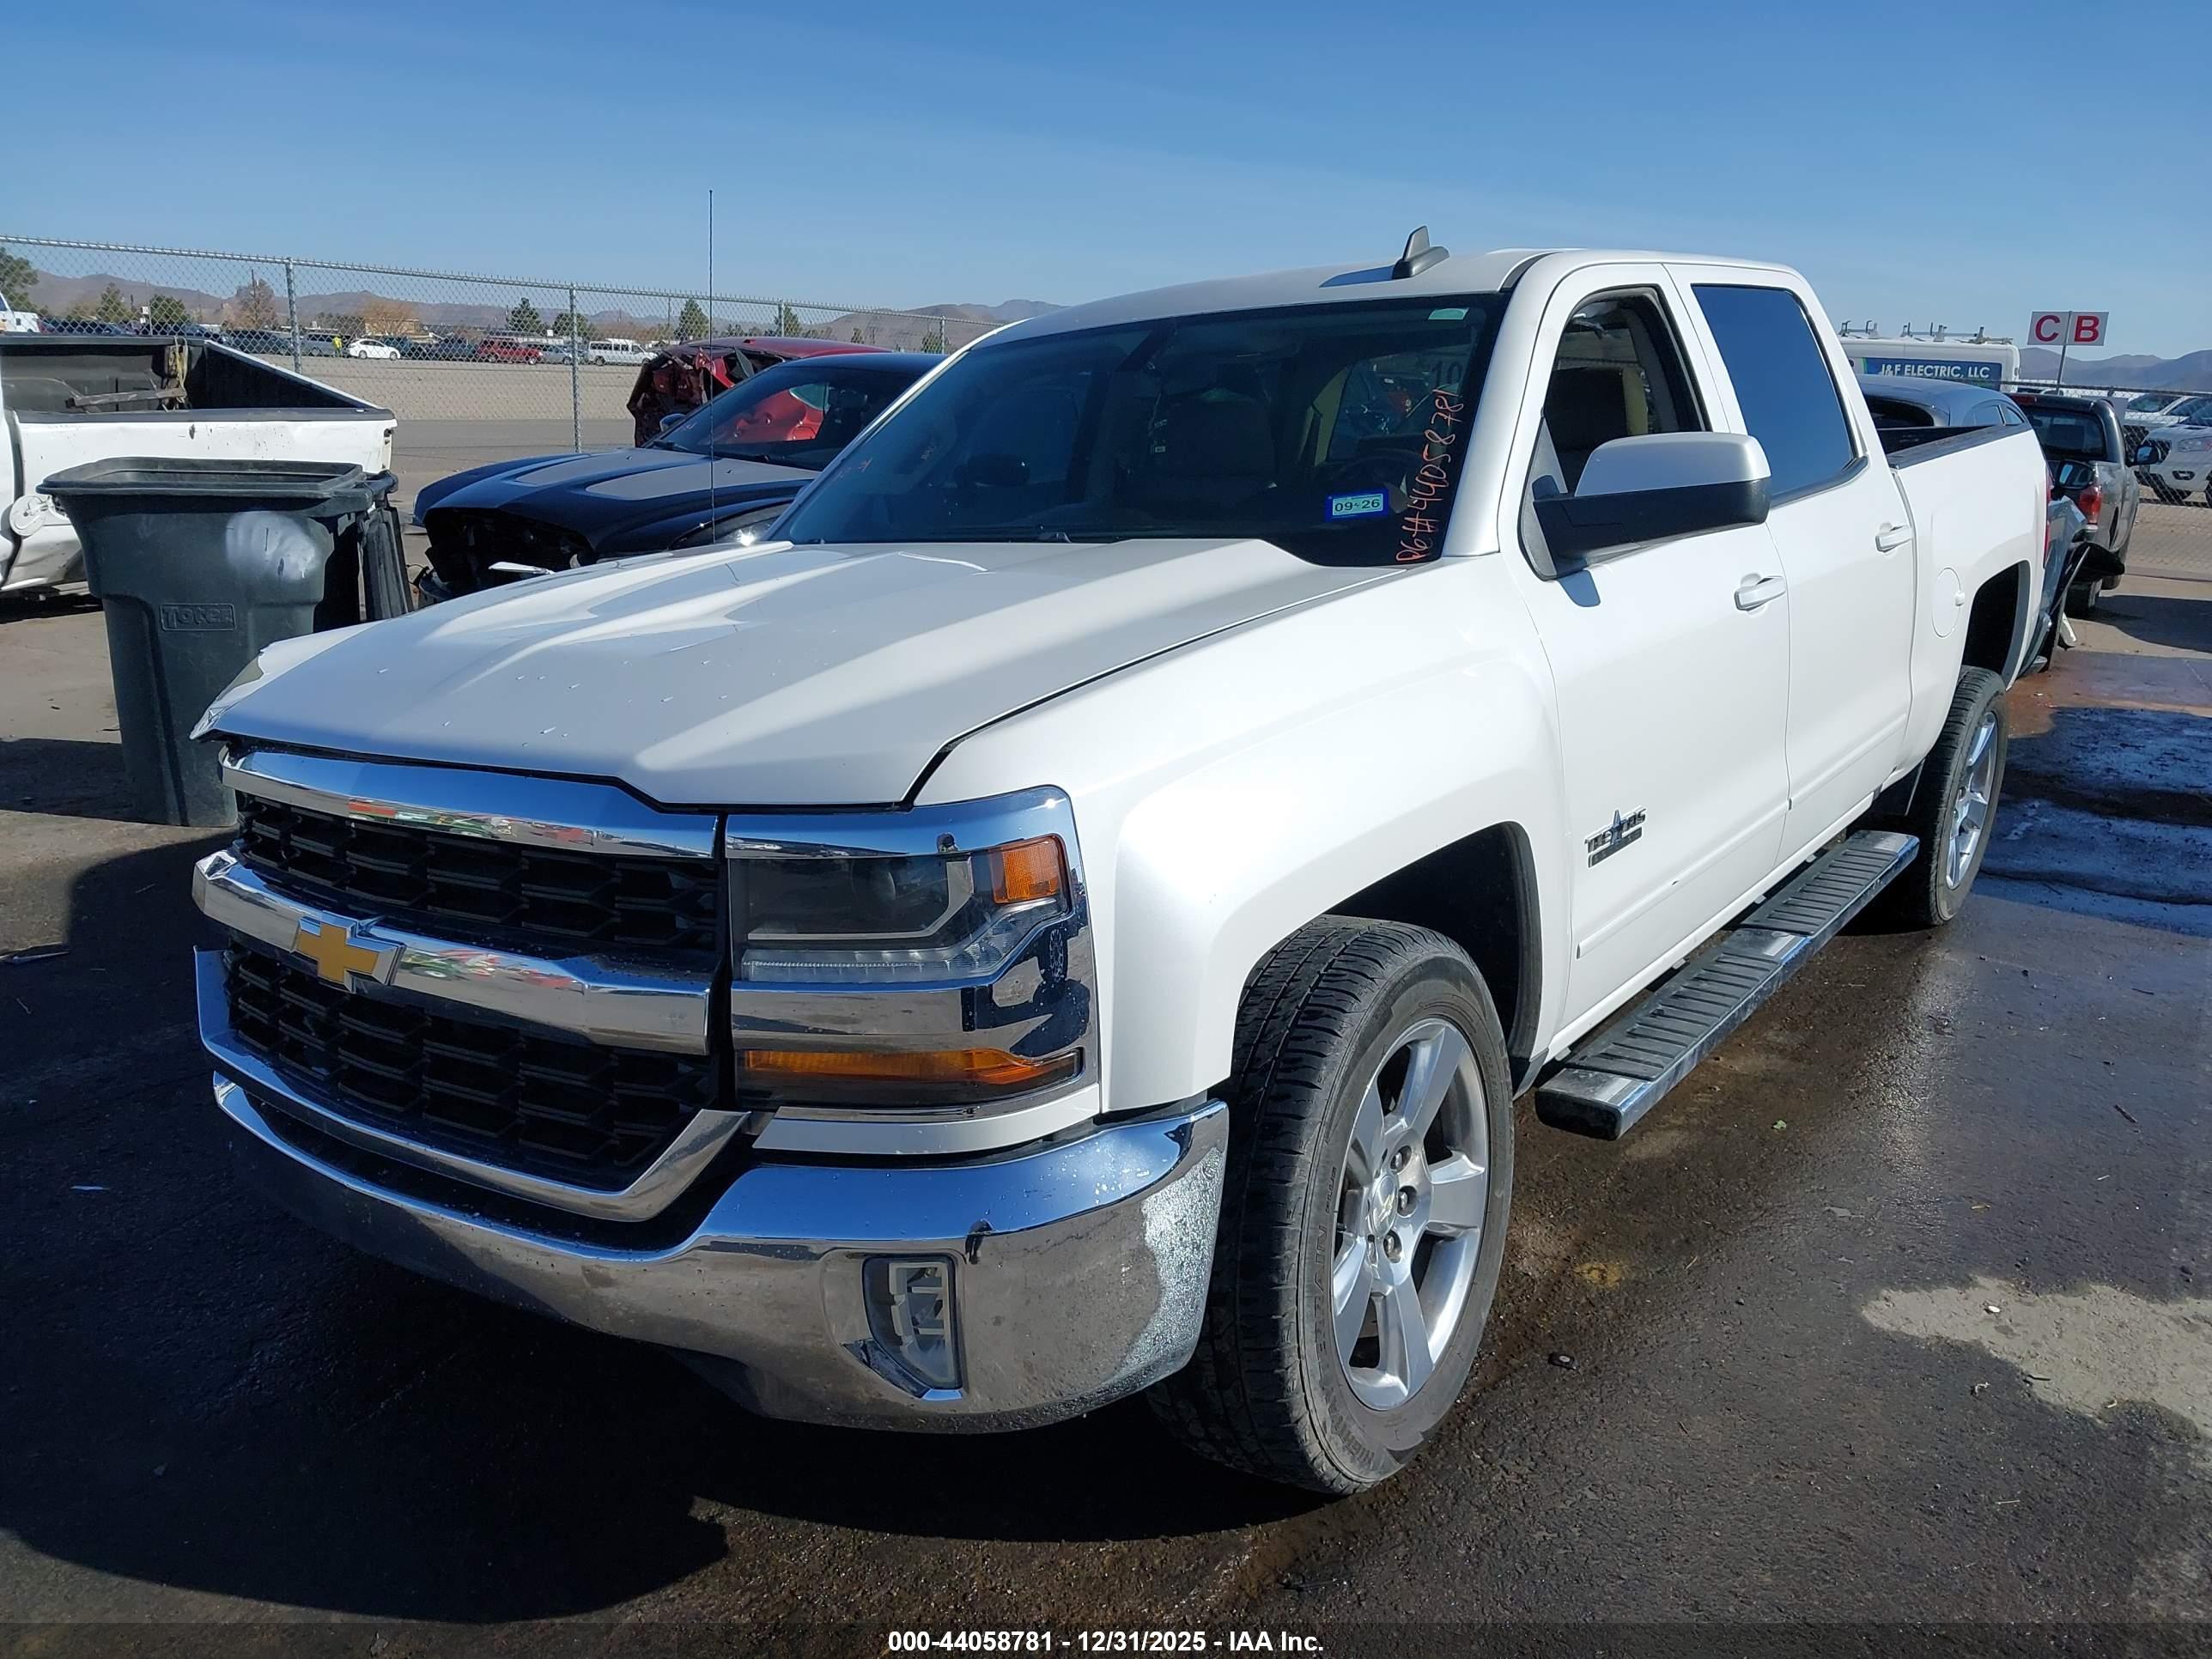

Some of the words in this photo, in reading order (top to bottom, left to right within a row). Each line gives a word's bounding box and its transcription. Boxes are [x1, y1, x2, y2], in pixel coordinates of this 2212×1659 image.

[2035, 314, 2061, 343] C
[2074, 315, 2100, 343] B
[1904, 364, 1965, 379] ELECTRIC,
[1967, 366, 1990, 379] LLC
